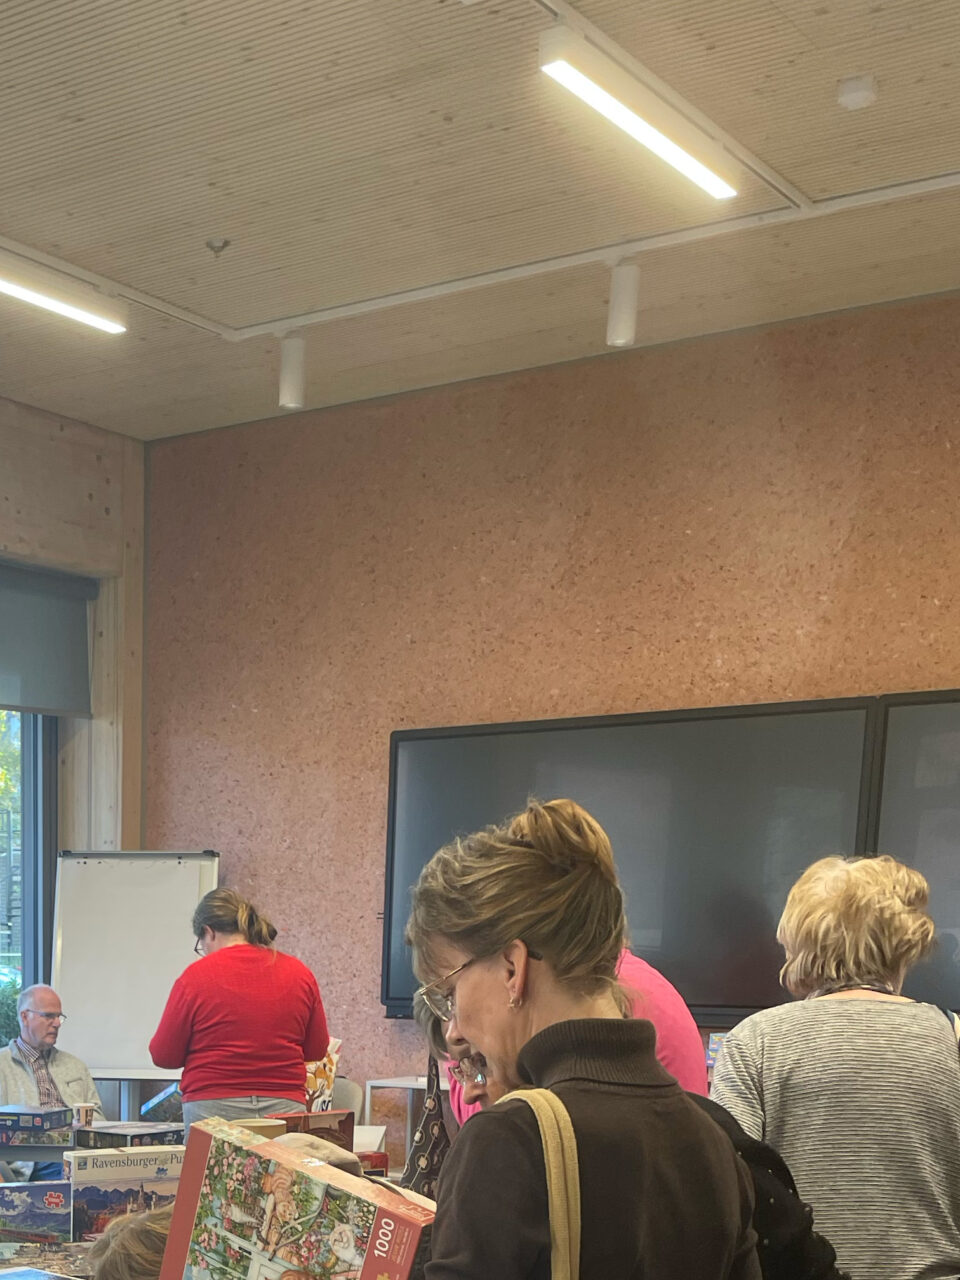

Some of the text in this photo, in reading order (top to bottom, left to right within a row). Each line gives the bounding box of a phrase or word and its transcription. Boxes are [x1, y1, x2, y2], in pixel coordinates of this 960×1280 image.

[92, 1153, 185, 1169] Ravensburger Pu
[373, 1218, 395, 1258] 1000
